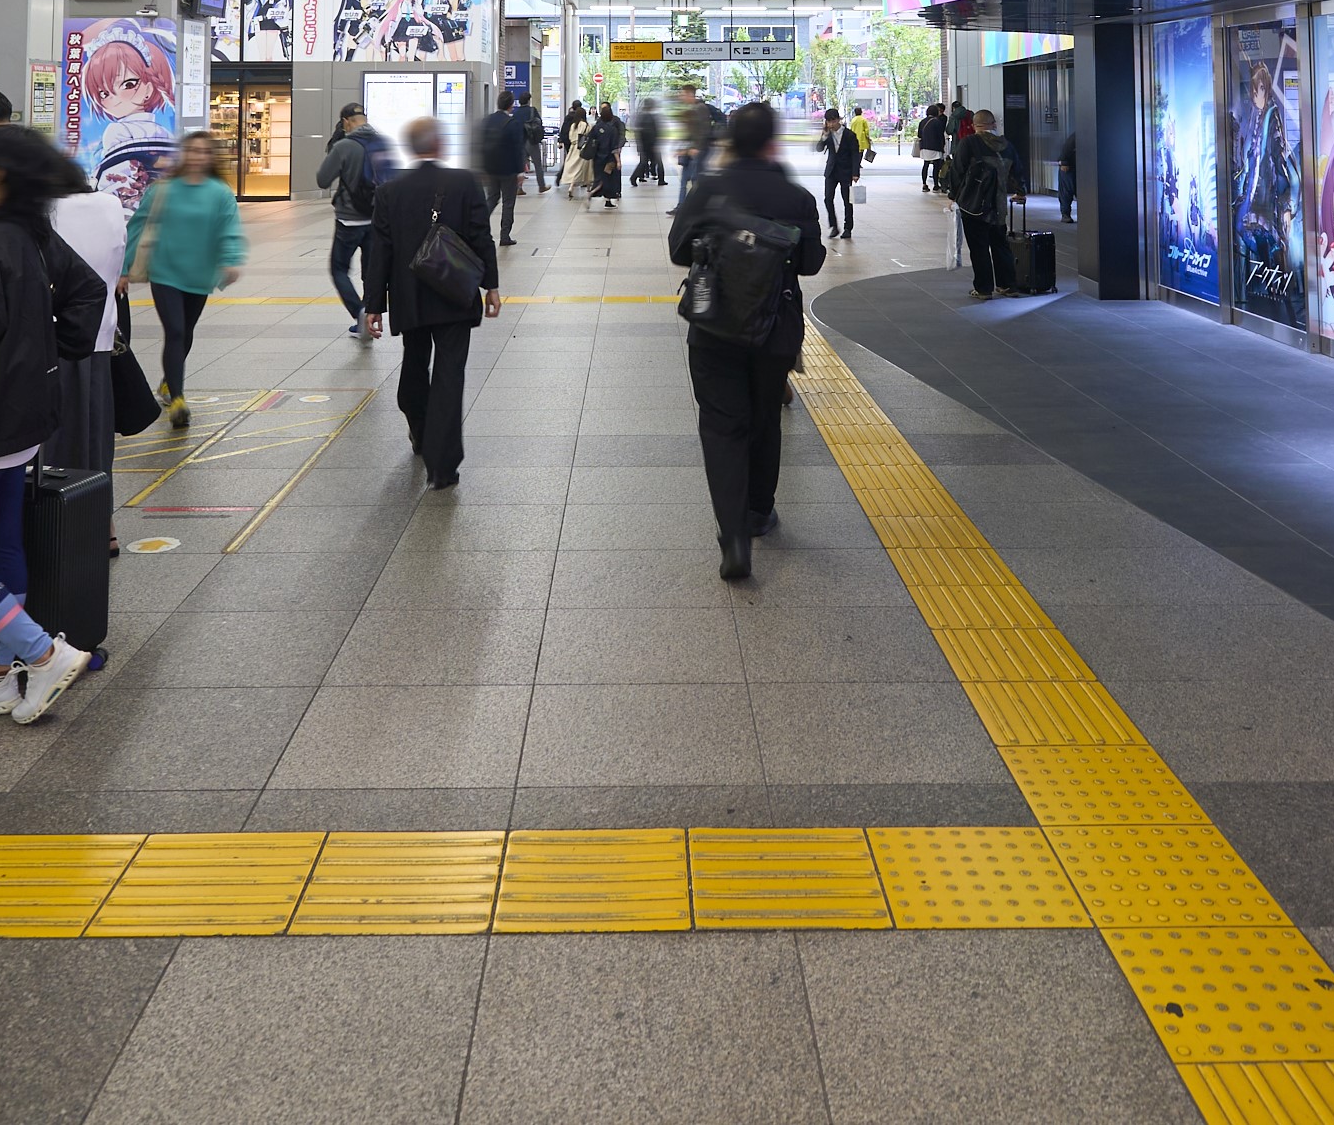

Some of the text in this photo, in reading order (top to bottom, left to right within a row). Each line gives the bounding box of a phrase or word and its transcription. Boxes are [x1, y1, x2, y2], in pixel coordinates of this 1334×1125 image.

[1168, 245, 1211, 268] ブルーアーカイブ
